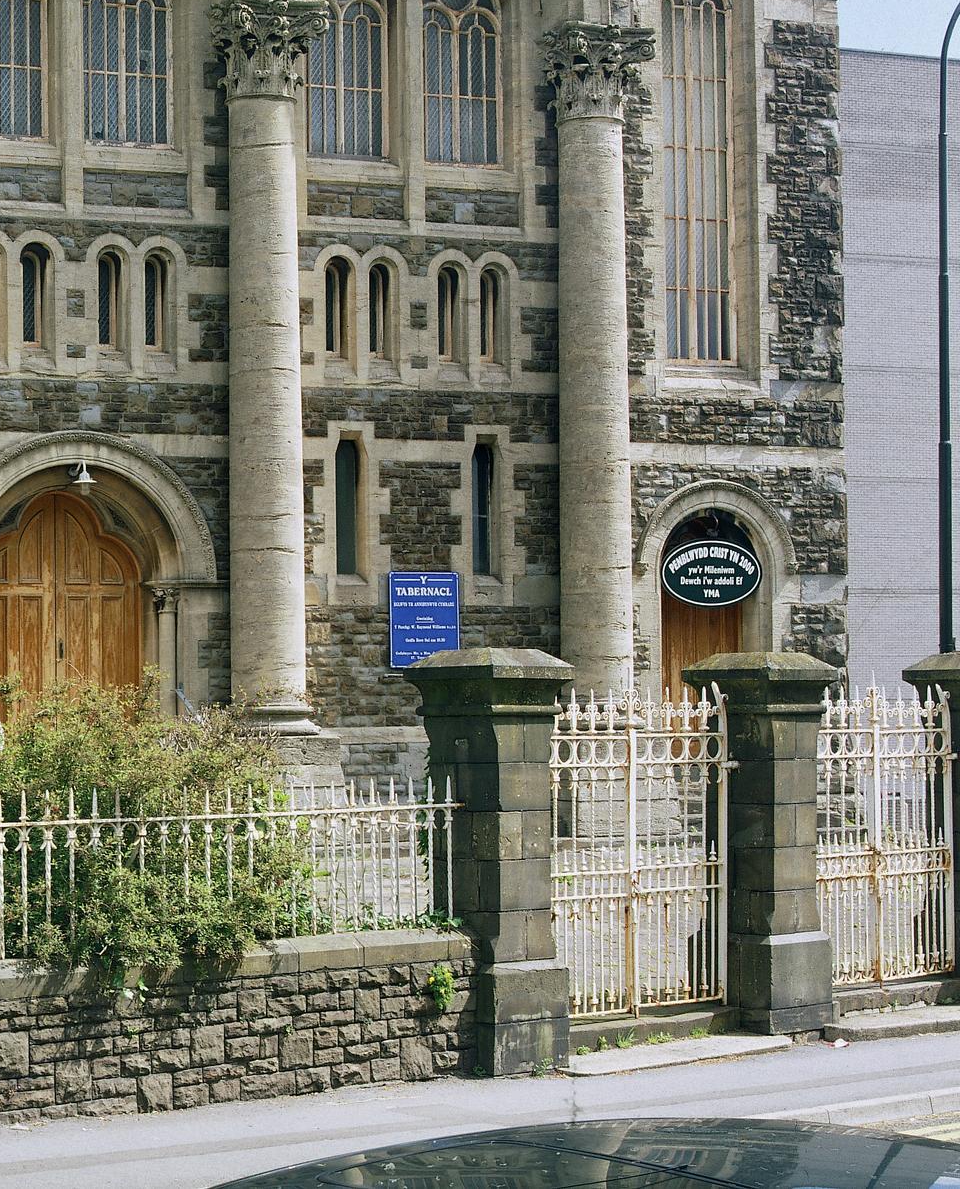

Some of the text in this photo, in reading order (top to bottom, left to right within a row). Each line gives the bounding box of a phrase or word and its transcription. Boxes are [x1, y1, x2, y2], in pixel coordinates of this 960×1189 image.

[669, 547, 708, 574] PENBLWYDD
[709, 546, 729, 559] CRIST
[738, 556, 755, 575] 2000
[688, 565, 735, 576] yw'r Mileniwm
[420, 575, 428, 584] Y
[680, 576, 701, 585] Dewch
[714, 576, 734, 585] addoli
[736, 576, 743, 585] Ef
[395, 587, 452, 596] TABERNACL
[703, 589, 720, 598] YMA
